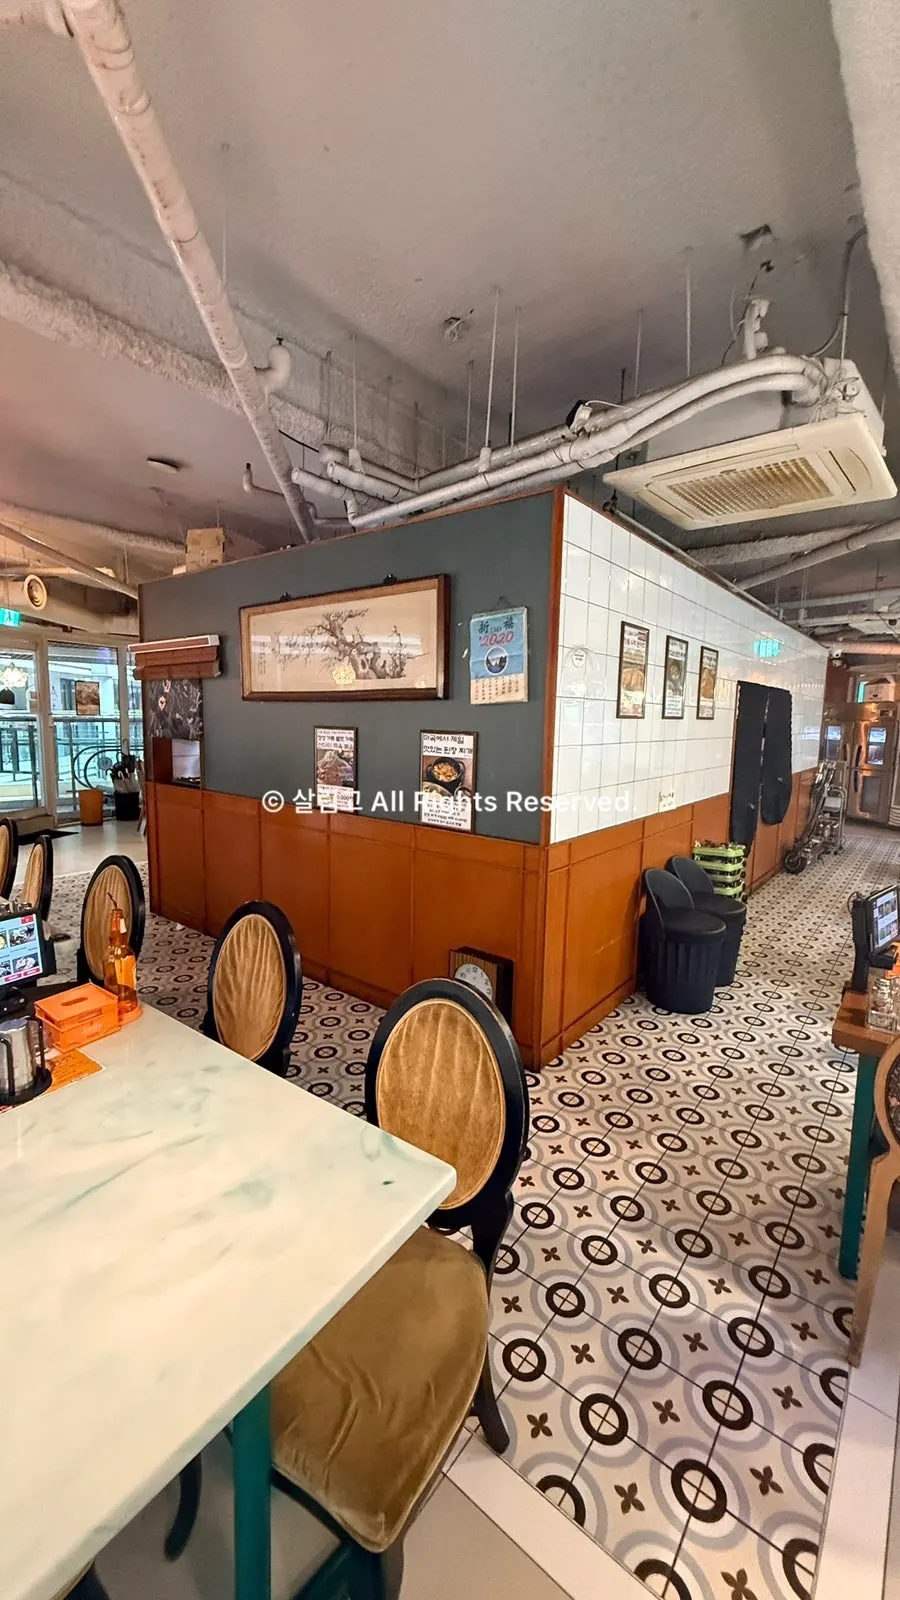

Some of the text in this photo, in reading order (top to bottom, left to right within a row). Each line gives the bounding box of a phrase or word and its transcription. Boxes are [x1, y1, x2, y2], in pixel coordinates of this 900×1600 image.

[423, 735, 464, 744] 마곡에서 제일
[423, 745, 442, 754] 맛있는
